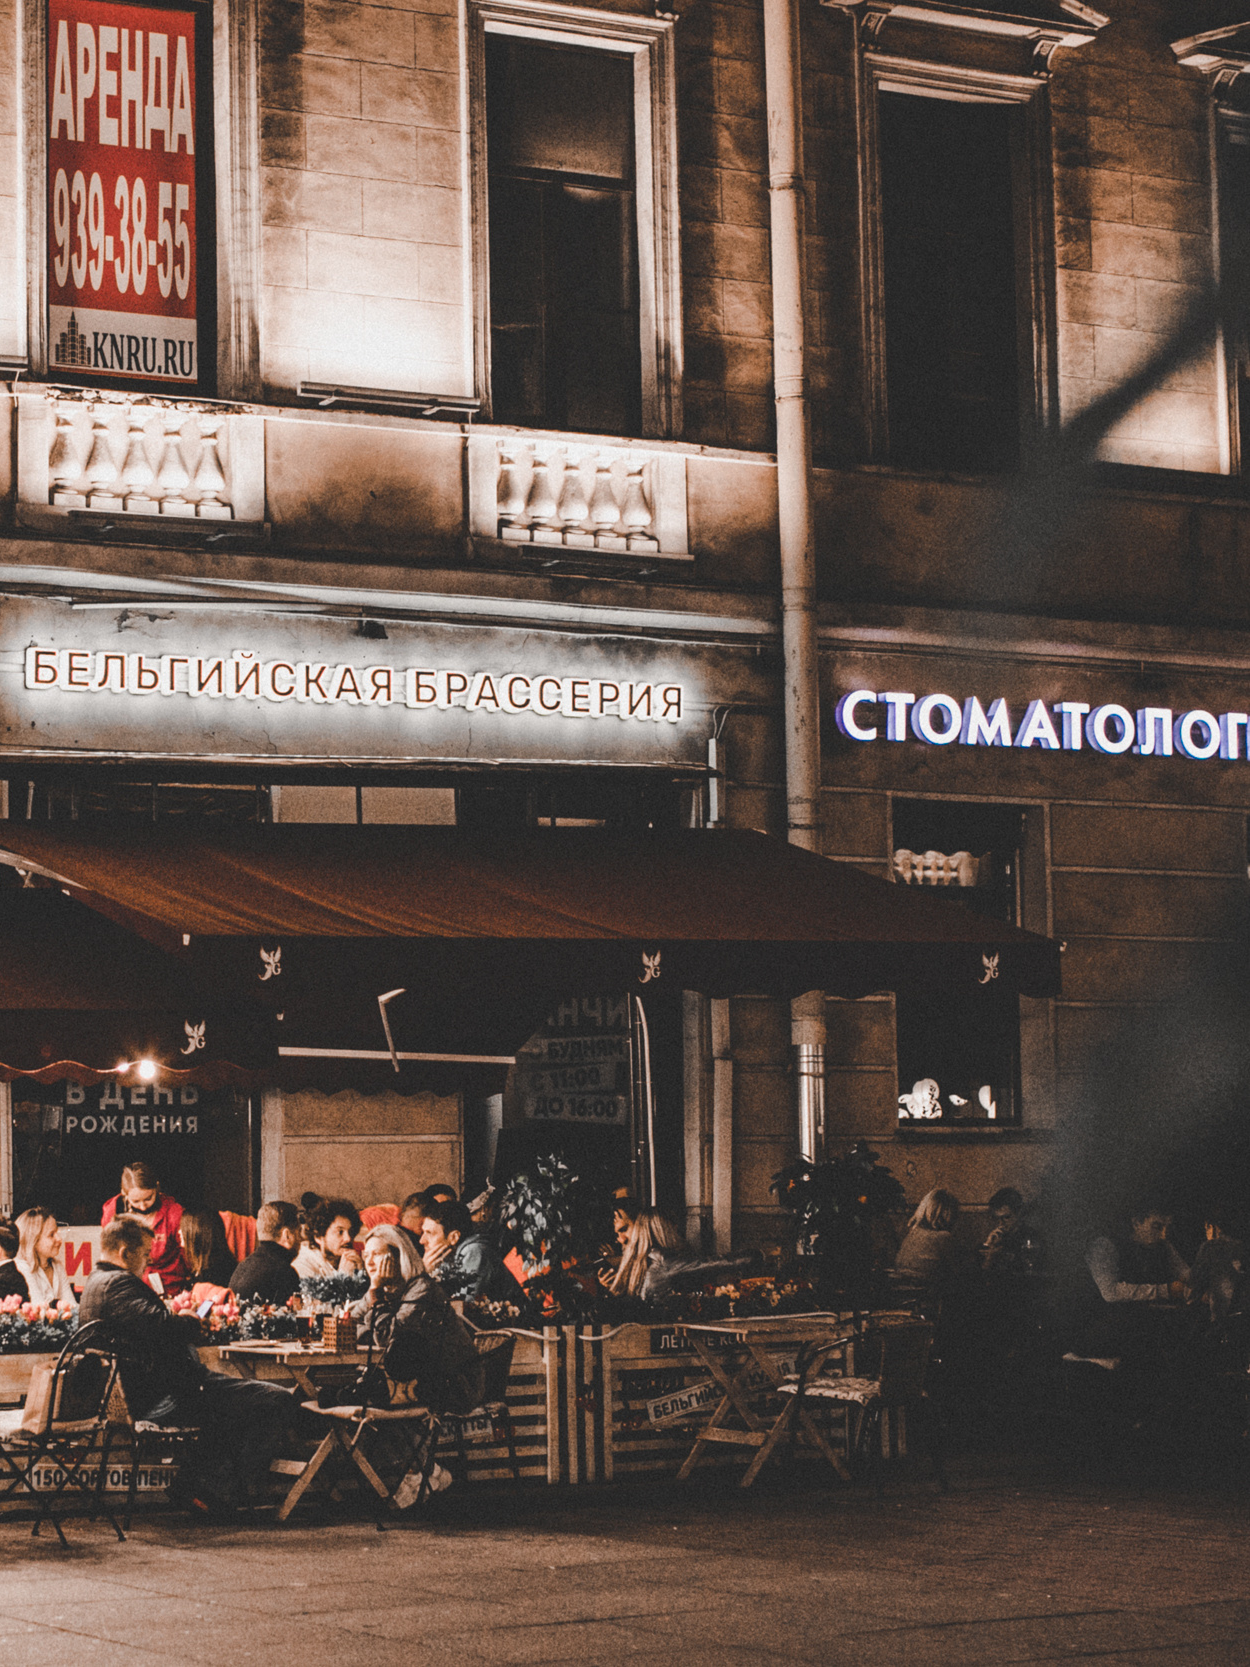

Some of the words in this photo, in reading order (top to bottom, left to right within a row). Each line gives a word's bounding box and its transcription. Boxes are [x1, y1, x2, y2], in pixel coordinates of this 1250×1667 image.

[51, 19, 195, 156] АРЕНДА
[53, 167, 191, 301] 939-38-55
[92, 330, 195, 378] KNRU.RU
[33, 651, 393, 704] БЕЛЬГИЙСКАЯ
[414, 669, 684, 720] БРАССЕРИЯ
[836, 689, 1250, 761] СТОМАТОЛОГ
[65, 1115, 199, 1137] РОЖДЕНИЯ
